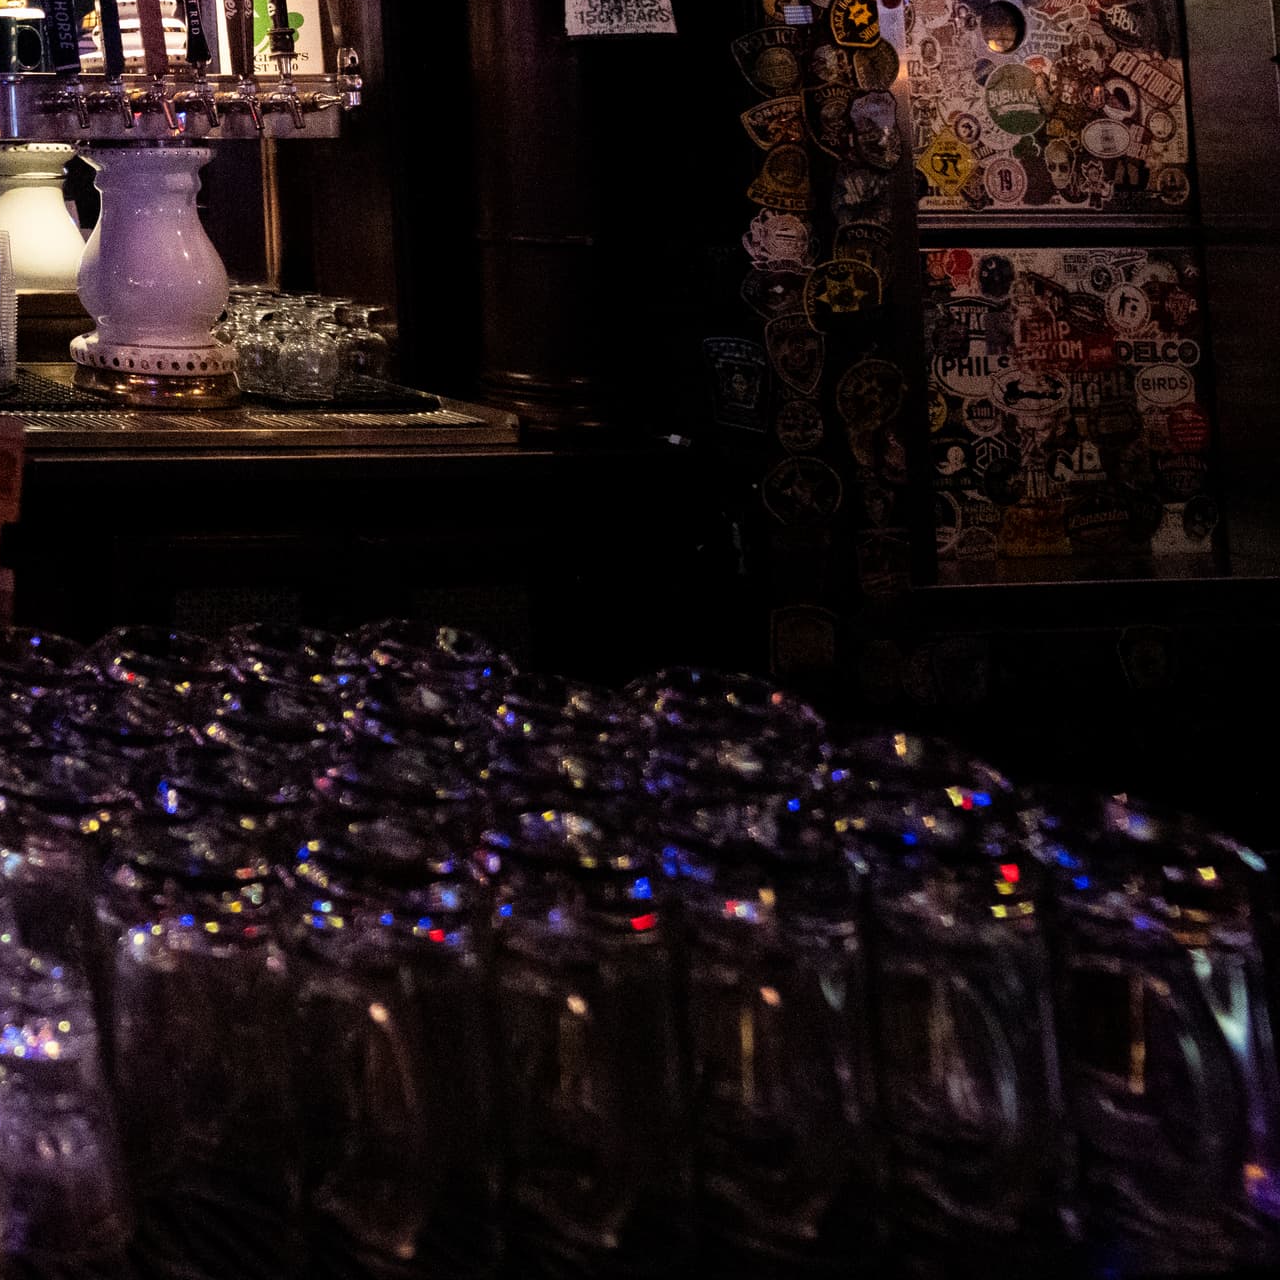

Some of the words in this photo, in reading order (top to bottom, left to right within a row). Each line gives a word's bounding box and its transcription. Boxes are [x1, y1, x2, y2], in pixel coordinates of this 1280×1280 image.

[189, 9, 200, 36] RED
[1109, 52, 1135, 78] RED
[1130, 61, 1183, 106] OCTOBER
[998, 168, 1013, 191] 19
[1116, 341, 1199, 363] DELCO
[1141, 377, 1189, 391] BIRDS
